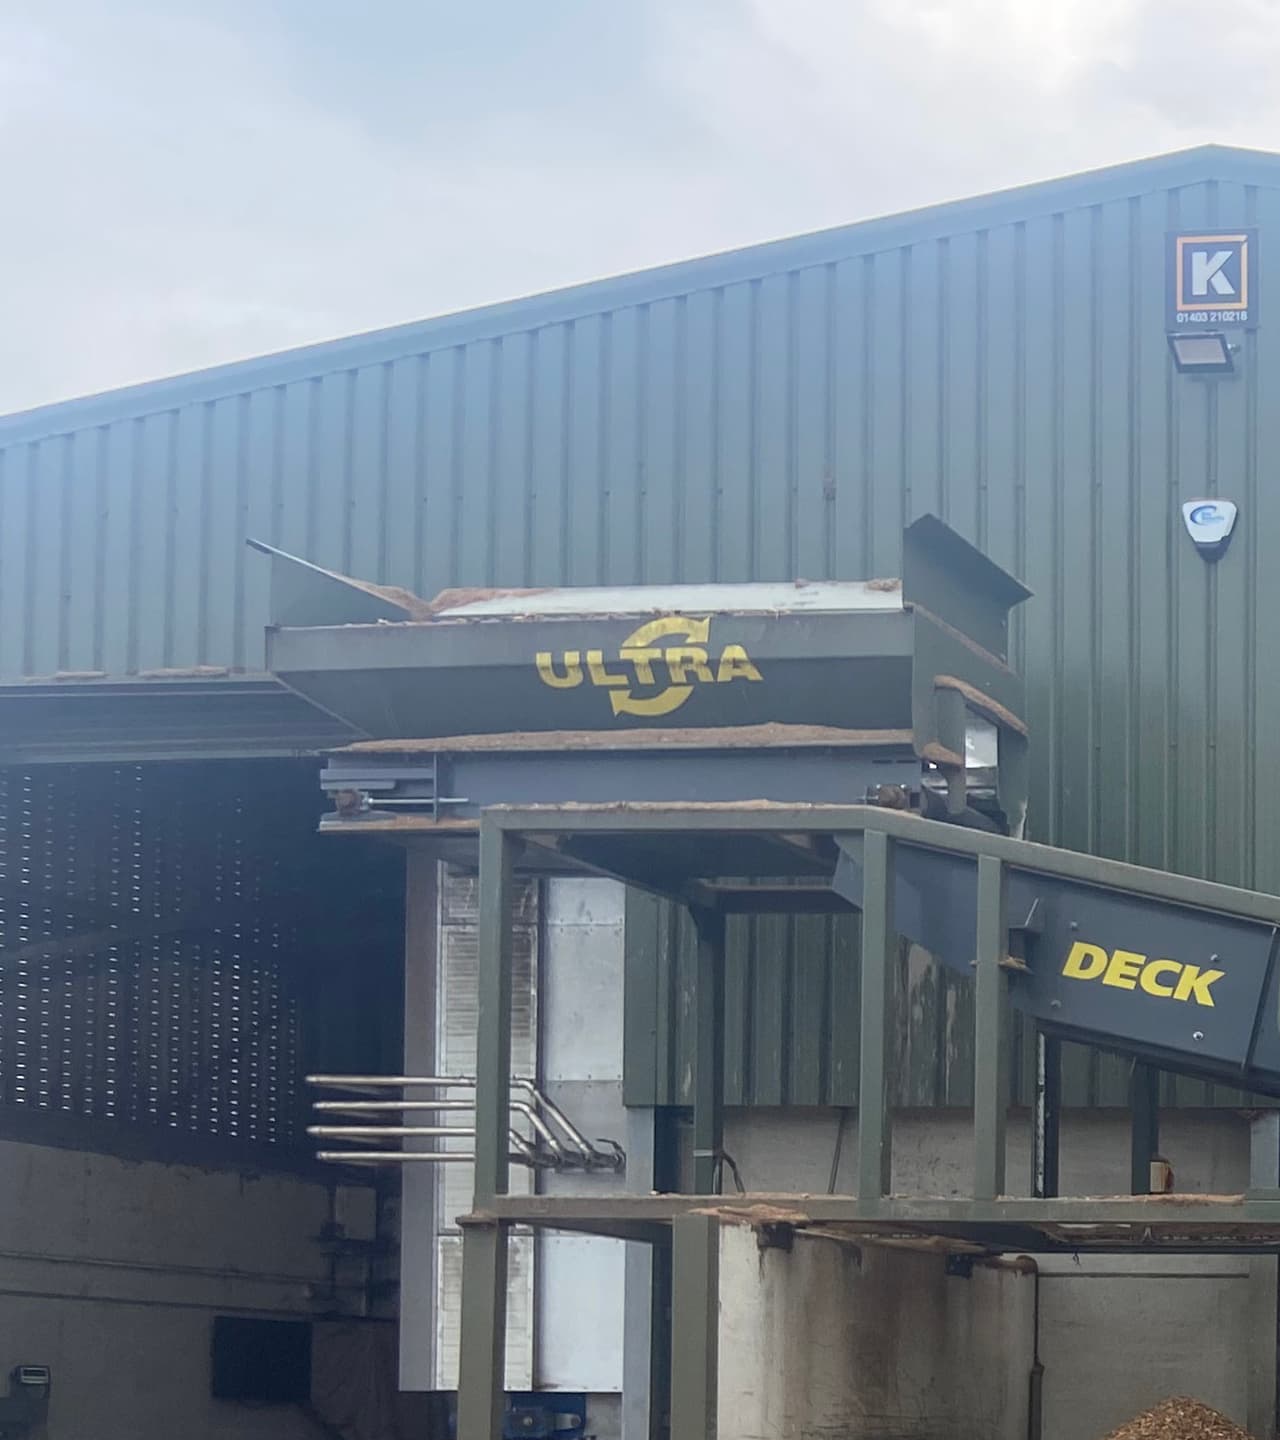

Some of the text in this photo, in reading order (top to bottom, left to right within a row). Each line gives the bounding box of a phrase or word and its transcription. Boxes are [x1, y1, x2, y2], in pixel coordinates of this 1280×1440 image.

[1191, 251, 1235, 296] K
[536, 645, 763, 689] ULTRA
[1062, 941, 1226, 1007] DECK
